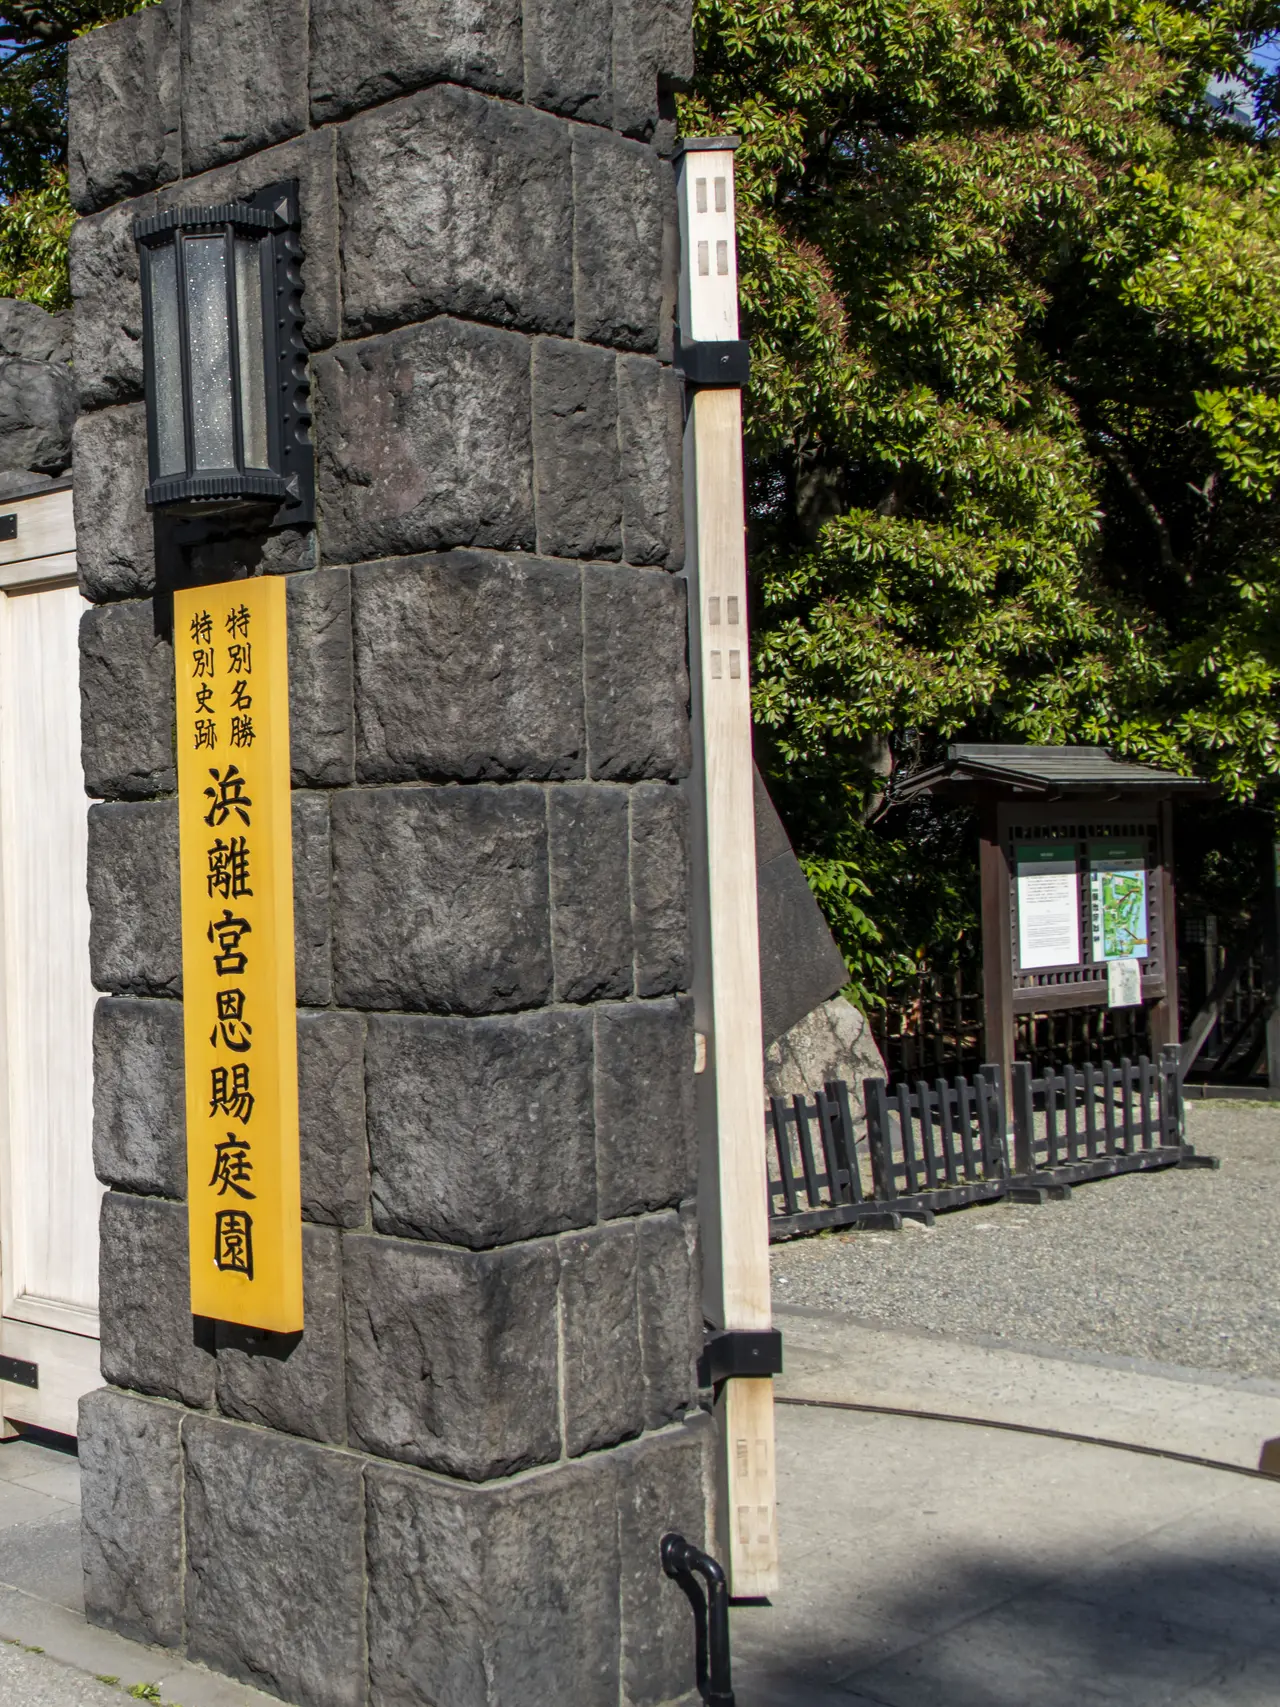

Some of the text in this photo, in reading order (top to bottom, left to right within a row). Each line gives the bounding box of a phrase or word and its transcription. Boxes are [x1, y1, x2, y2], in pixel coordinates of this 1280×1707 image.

[190, 609, 218, 751] 特別史跡
[225, 604, 256, 750] 特別名勝
[204, 765, 257, 1281] 浜離宮恩賜庭園
